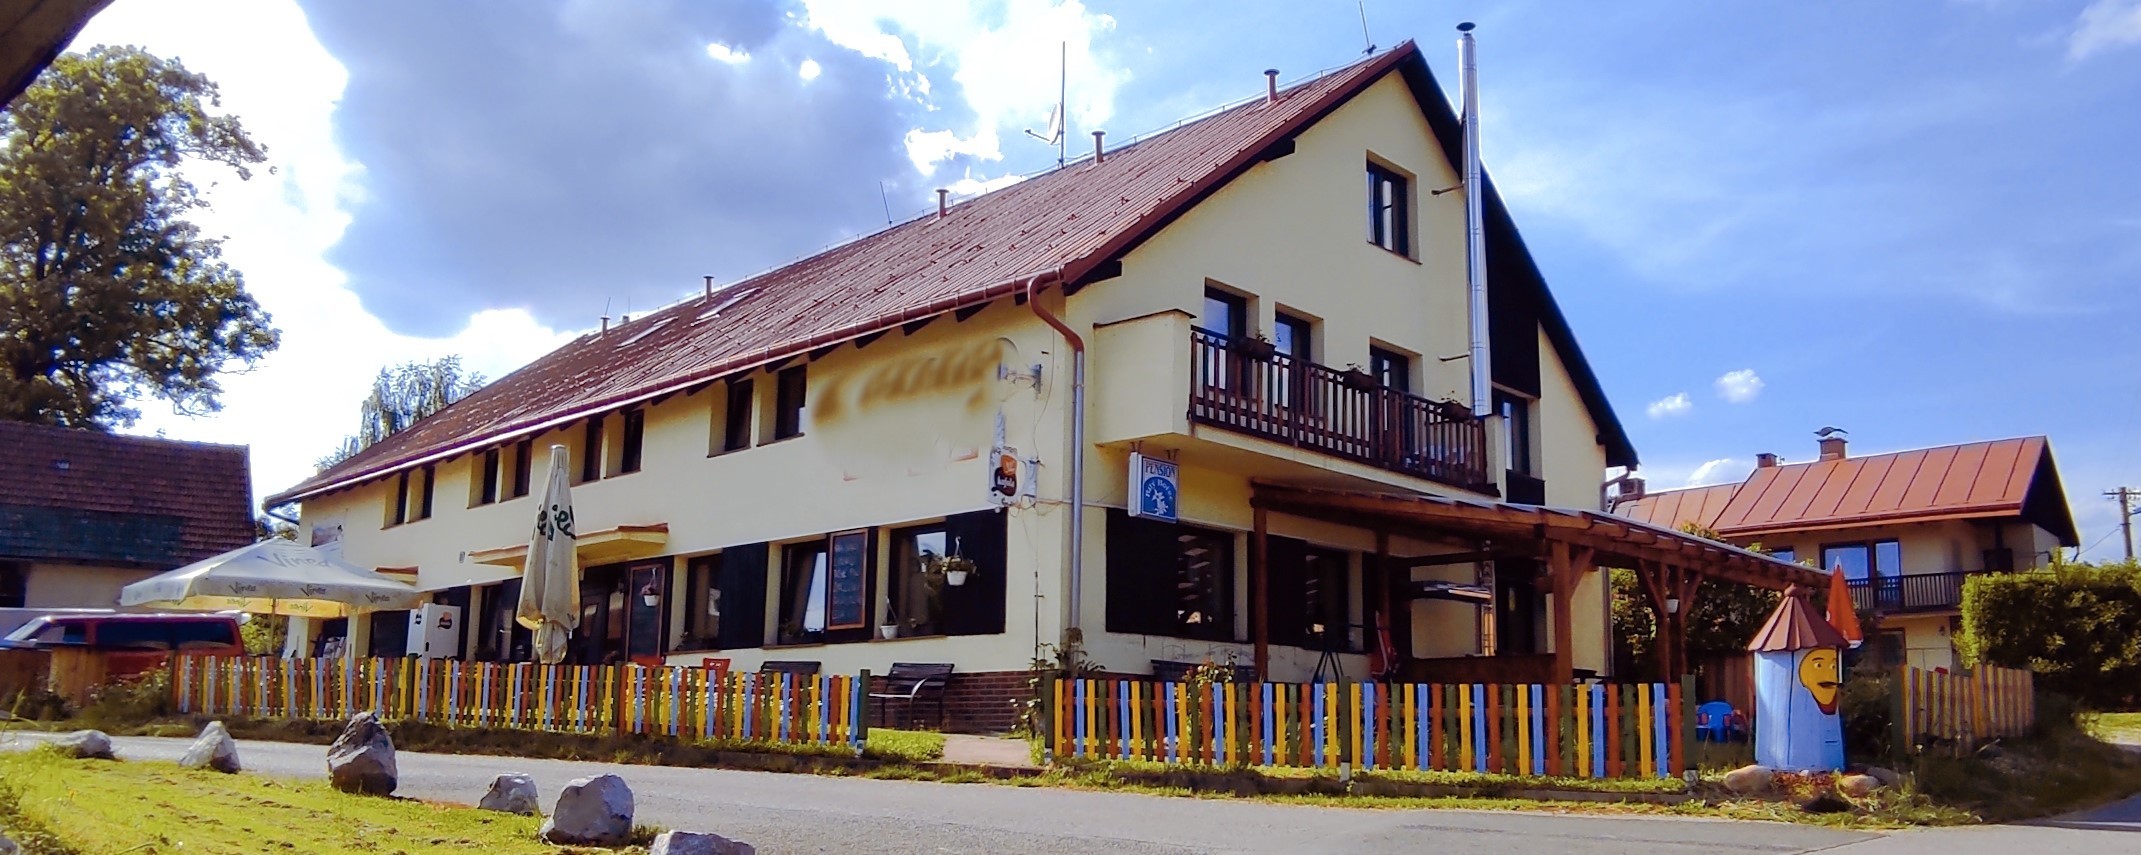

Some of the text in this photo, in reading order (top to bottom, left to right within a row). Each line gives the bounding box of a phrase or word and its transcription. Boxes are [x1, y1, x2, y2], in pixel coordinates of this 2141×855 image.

[1145, 461, 1175, 478] PENSION
[256, 552, 333, 568] Vinea
[228, 581, 257, 595] Vinea
[300, 583, 327, 597] Vinea
[365, 591, 391, 604] Vinea
